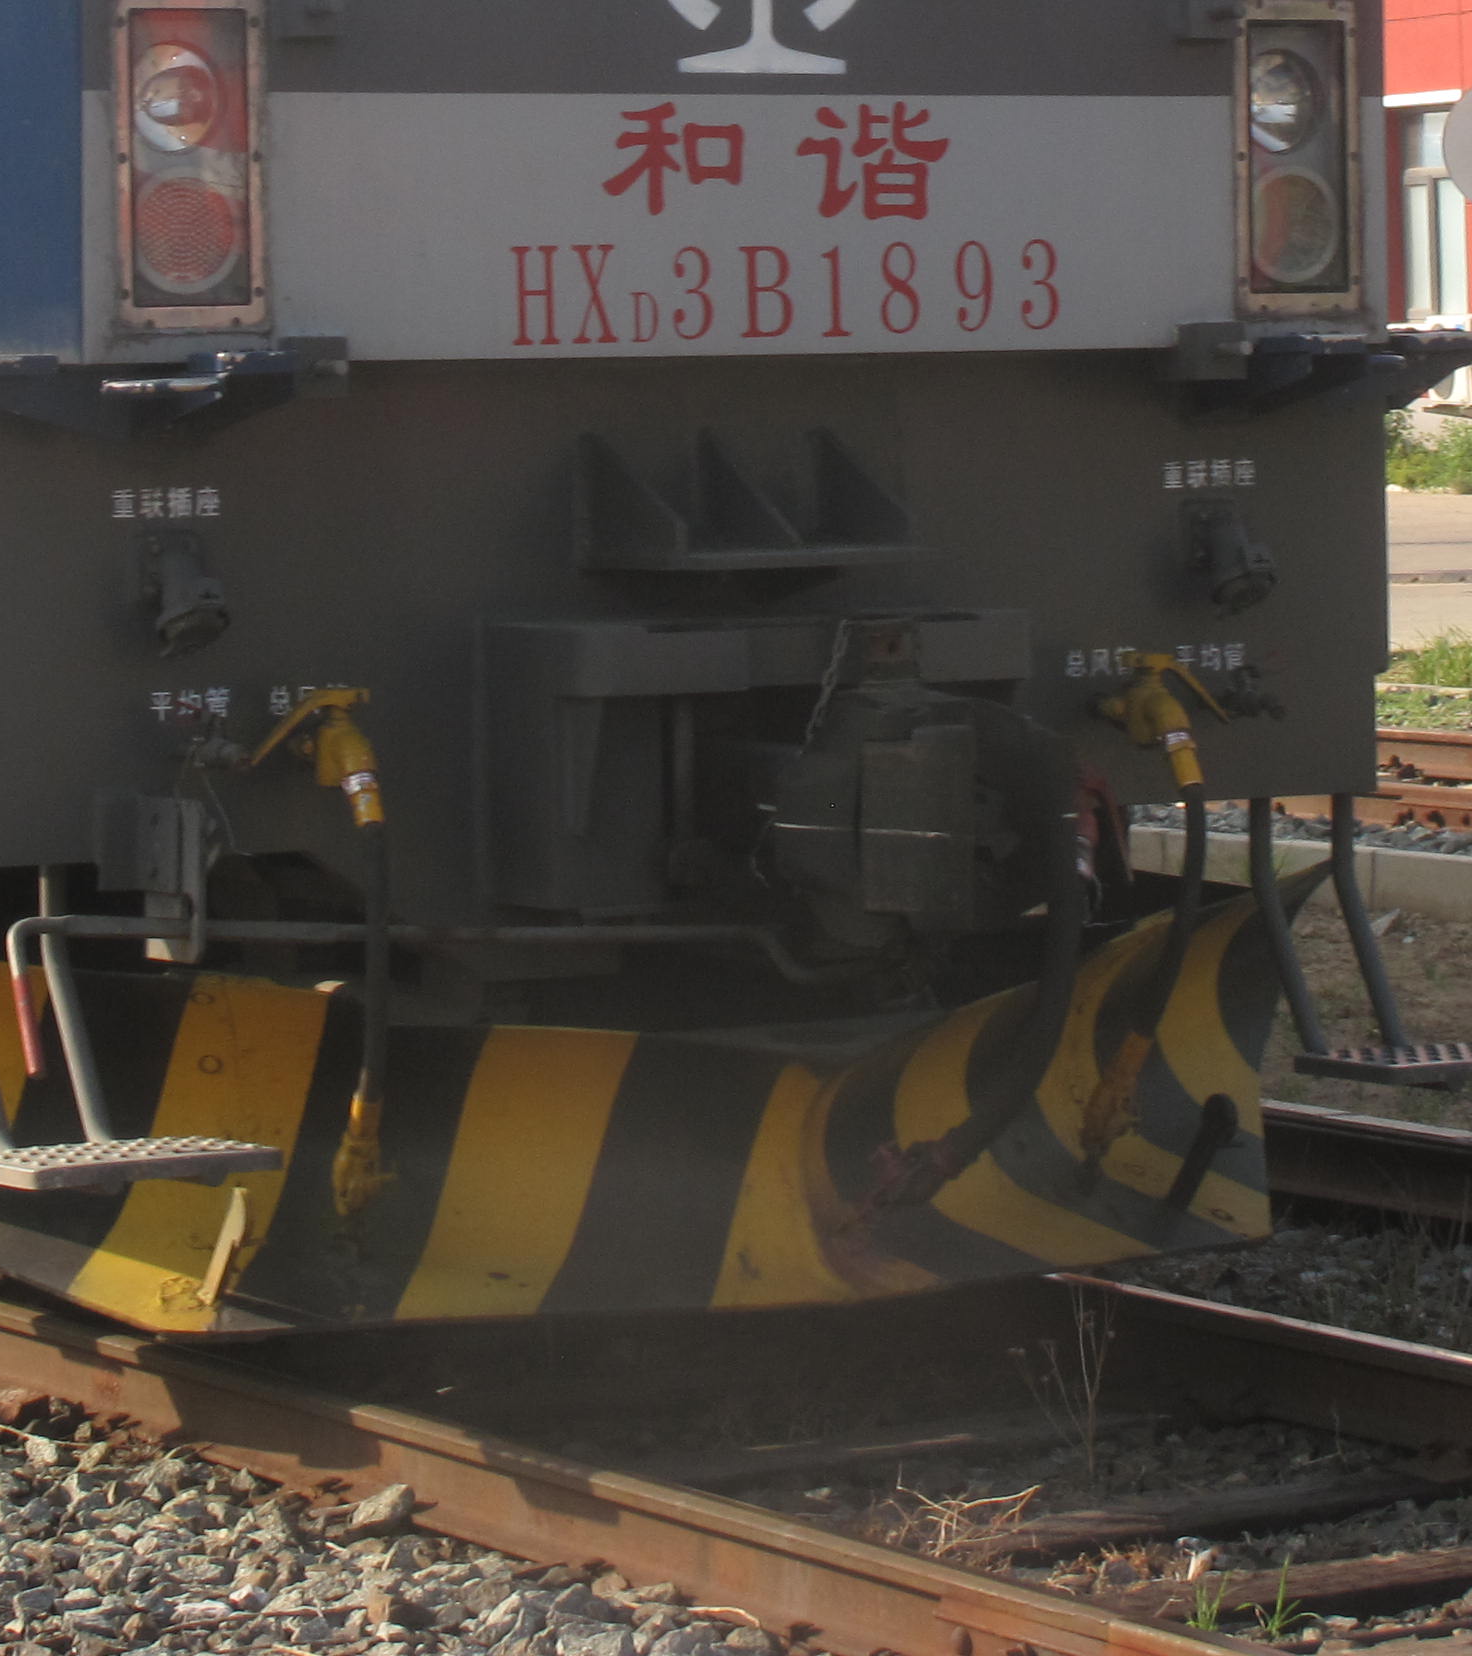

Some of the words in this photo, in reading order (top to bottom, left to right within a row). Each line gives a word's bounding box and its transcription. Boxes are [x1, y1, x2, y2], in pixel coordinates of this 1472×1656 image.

[602, 101, 950, 220] 和谐
[511, 239, 1061, 346] HXD3B1893
[111, 486, 221, 518] 重联插座
